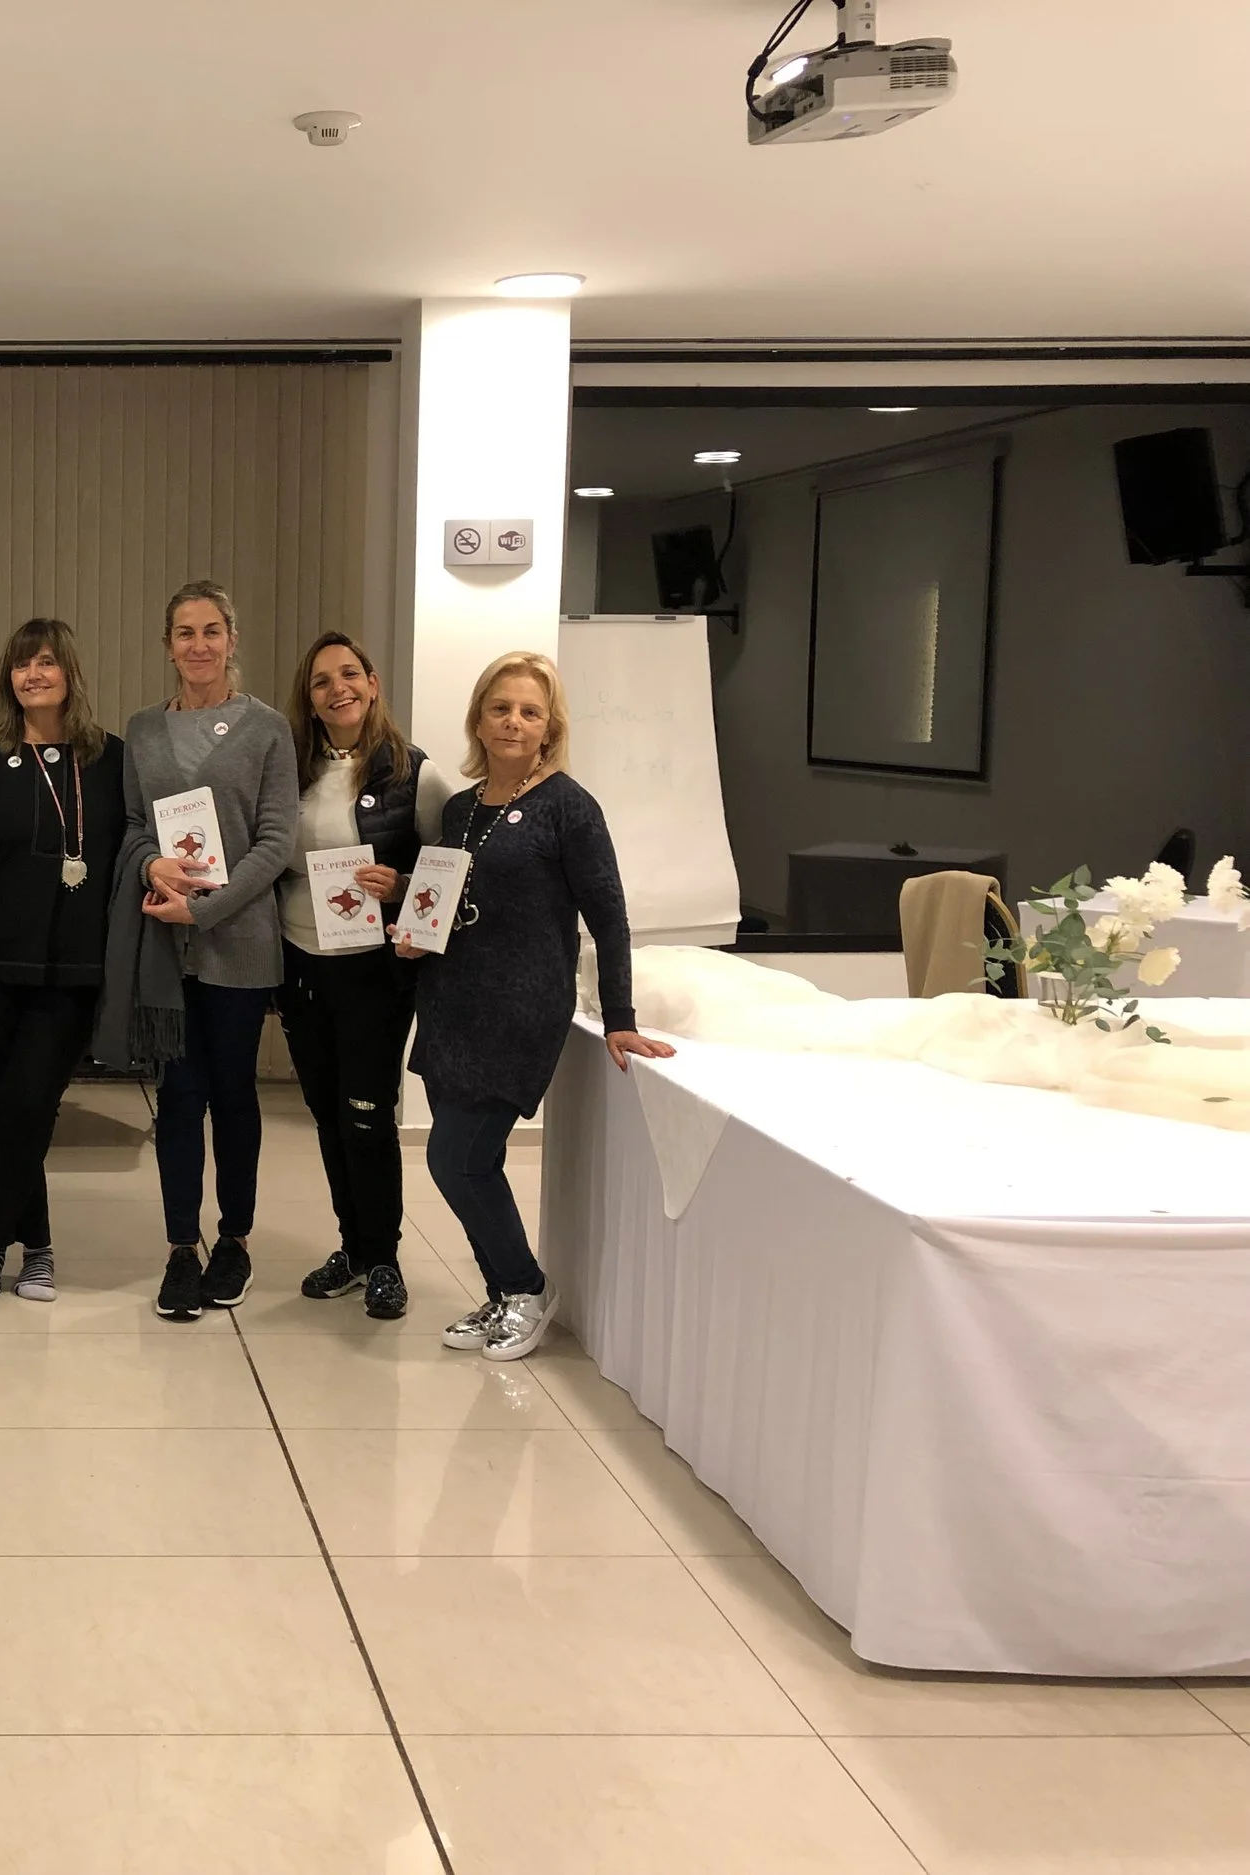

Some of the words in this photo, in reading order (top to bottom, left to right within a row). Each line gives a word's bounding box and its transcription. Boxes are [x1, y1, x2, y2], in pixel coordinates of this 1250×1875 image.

[158, 808, 170, 818] EL
[419, 856, 429, 866] EL
[313, 862, 327, 872] EL
